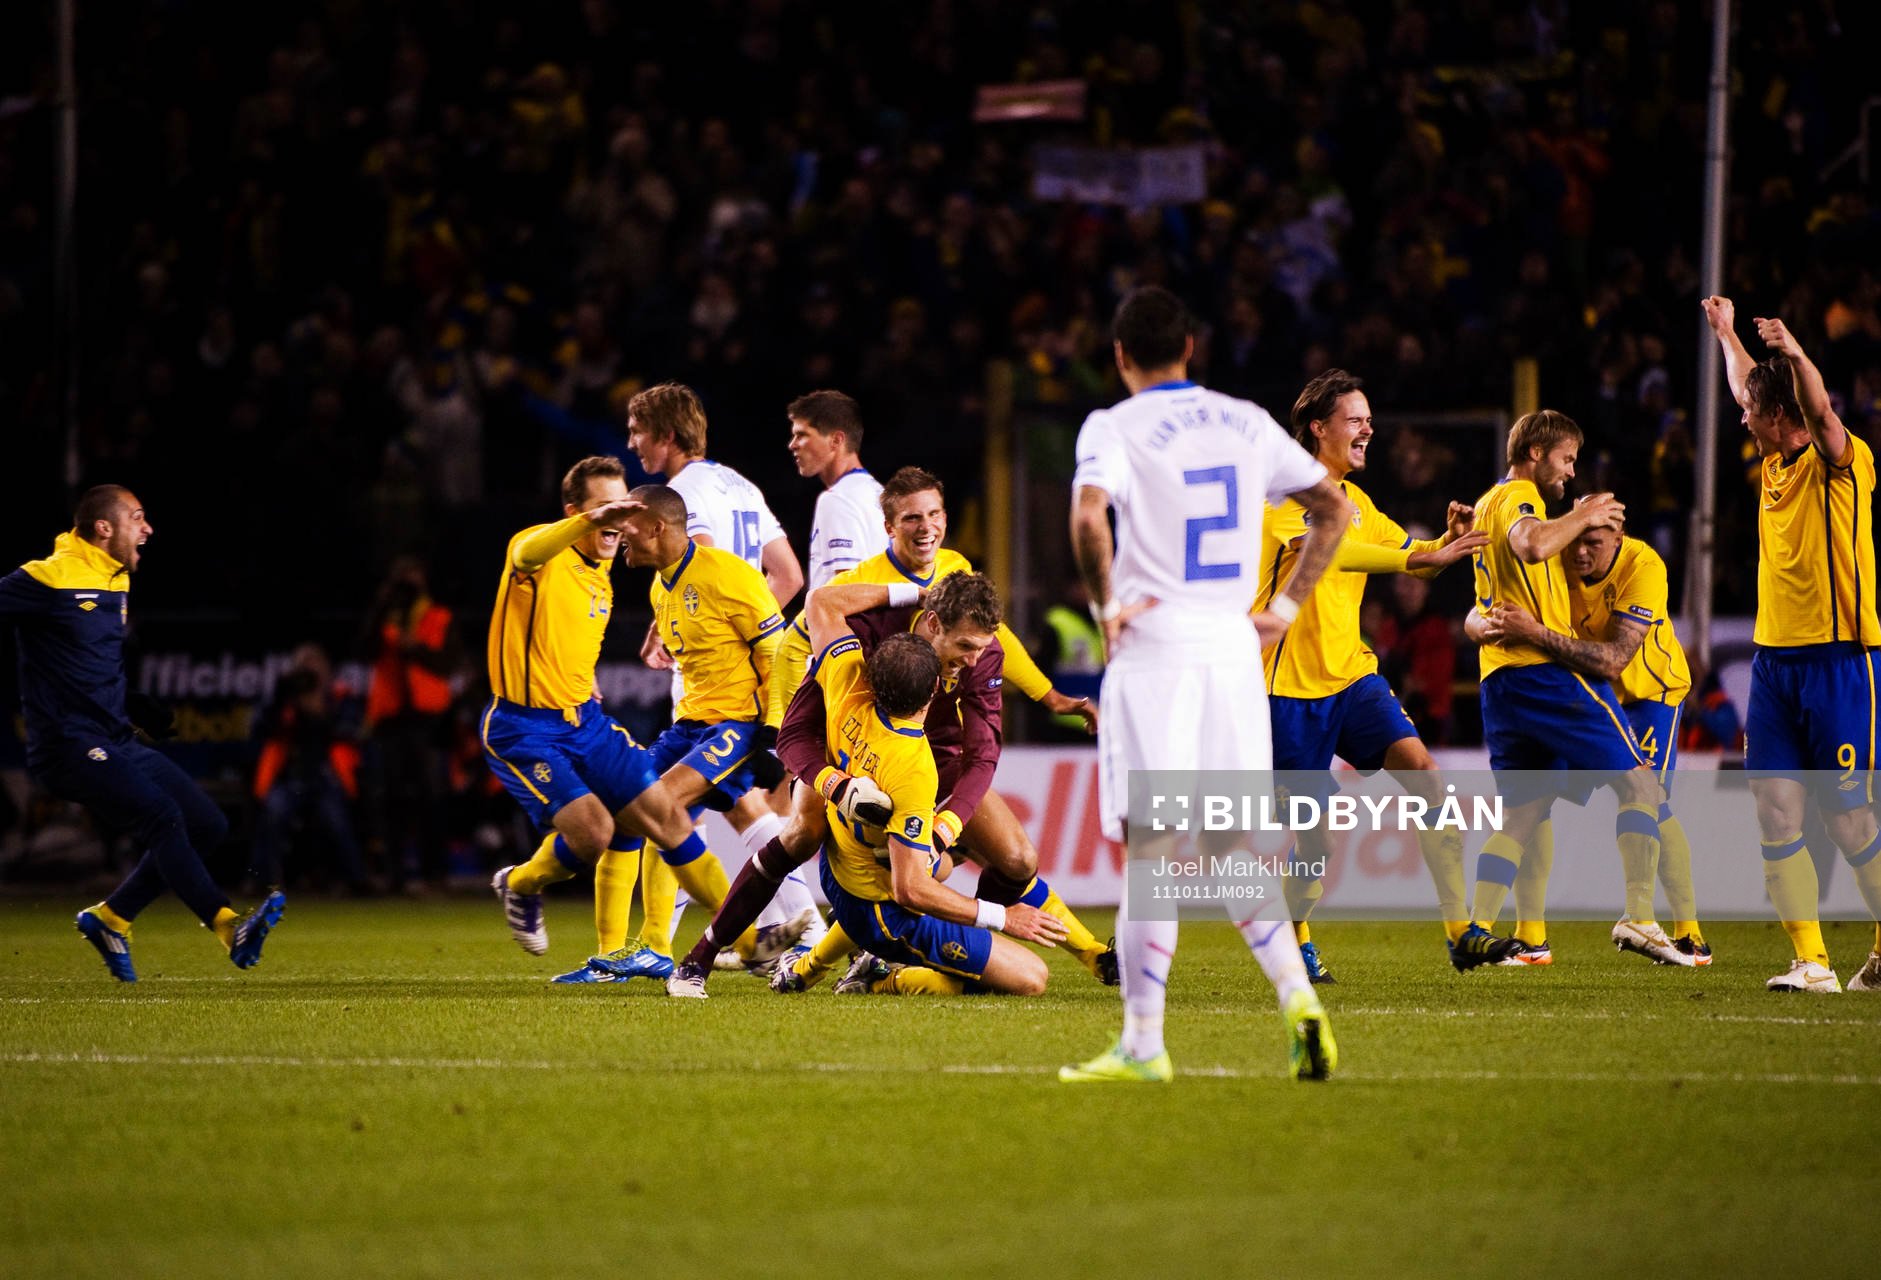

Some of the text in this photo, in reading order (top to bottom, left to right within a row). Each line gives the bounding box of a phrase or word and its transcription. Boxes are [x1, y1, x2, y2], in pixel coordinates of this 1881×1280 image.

[1183, 465, 1240, 582] 2
[709, 728, 741, 757] 5
[1640, 726, 1659, 758] 4
[1837, 743, 1857, 782] 9
